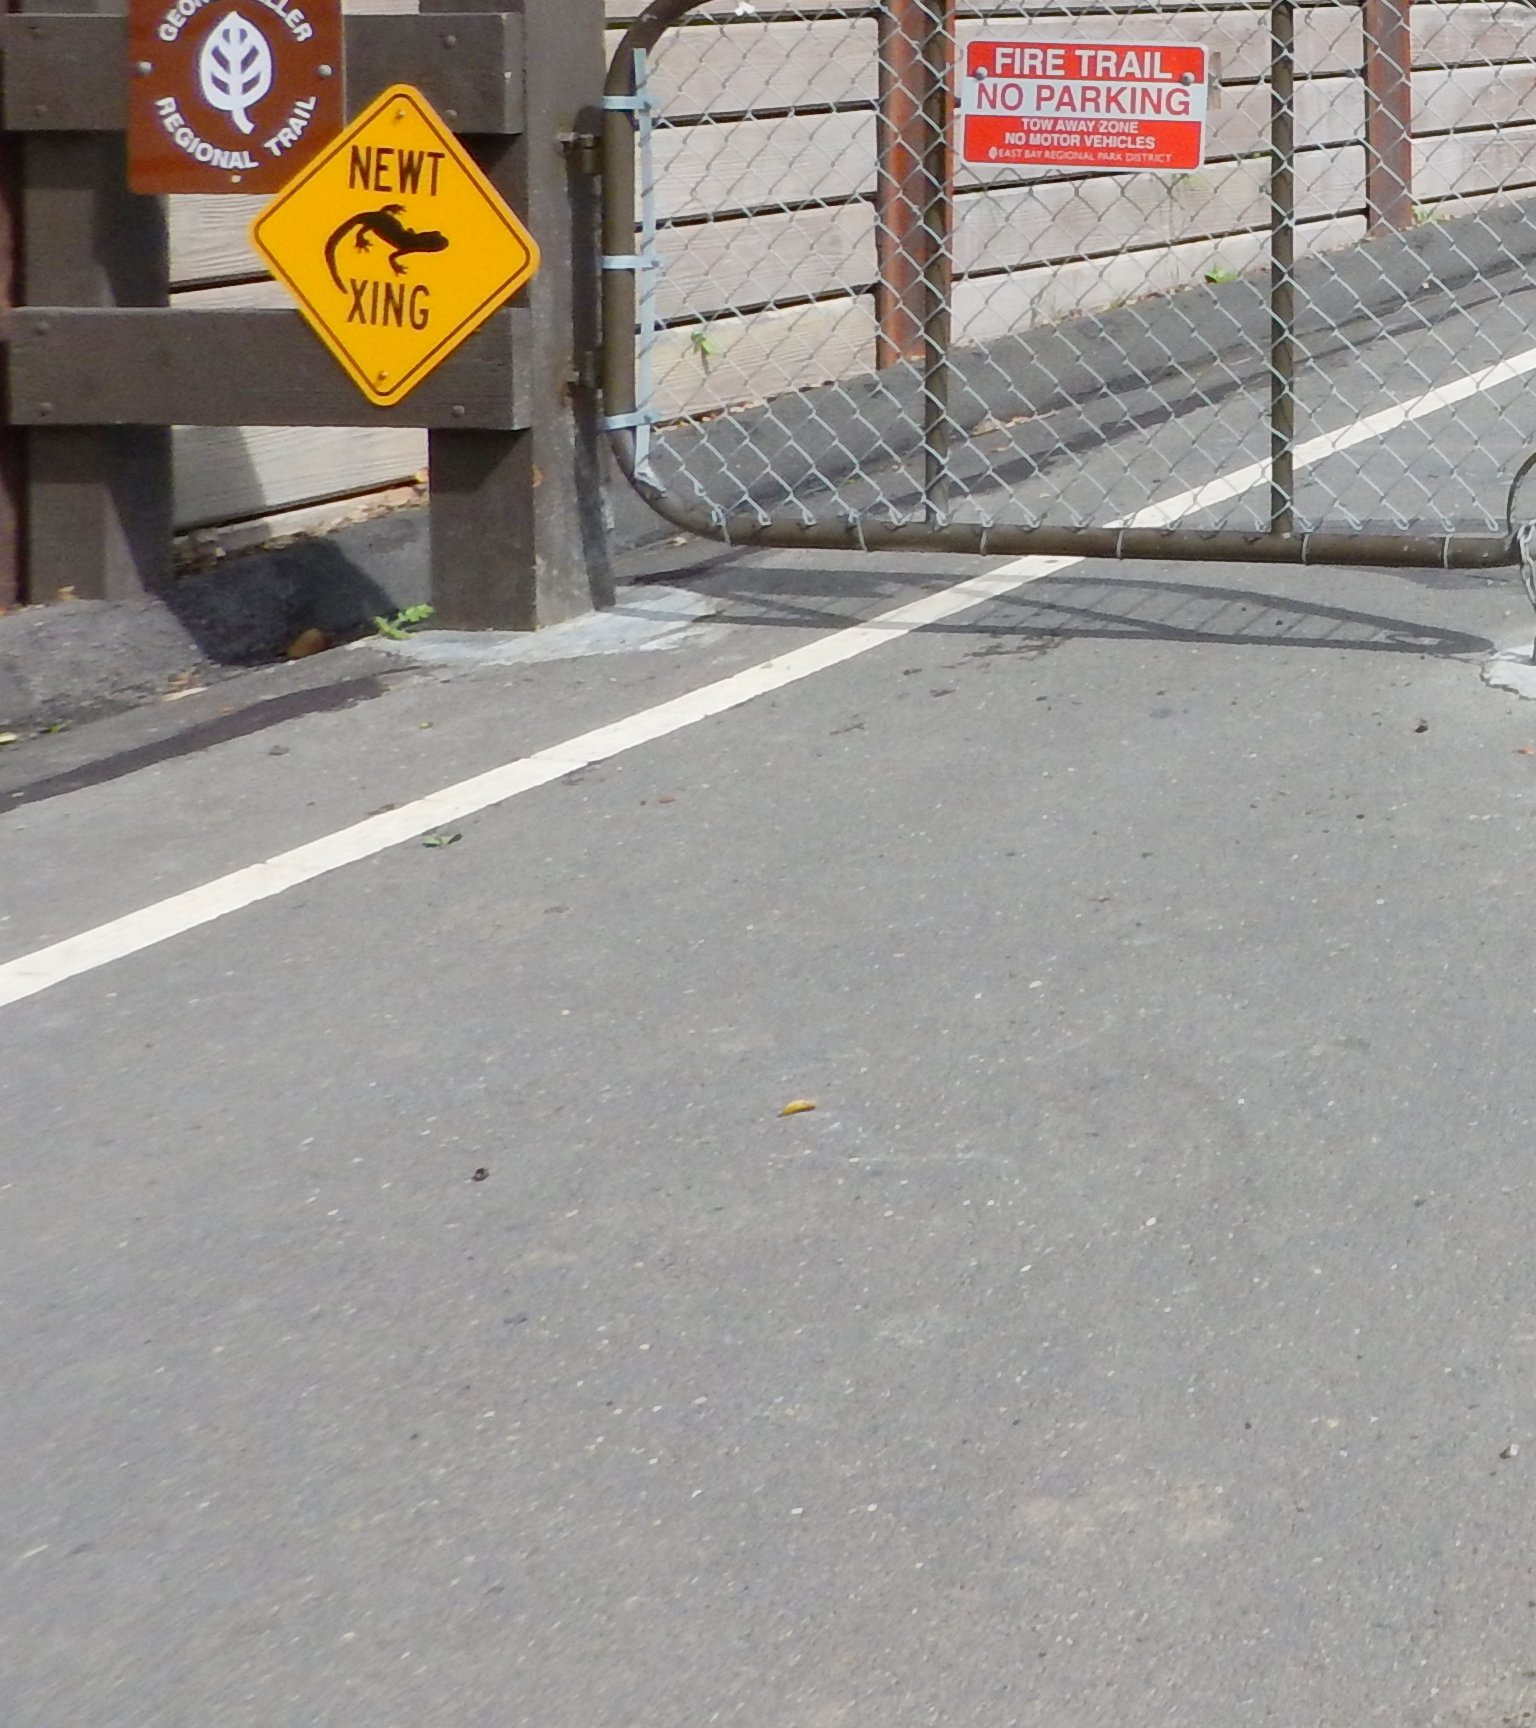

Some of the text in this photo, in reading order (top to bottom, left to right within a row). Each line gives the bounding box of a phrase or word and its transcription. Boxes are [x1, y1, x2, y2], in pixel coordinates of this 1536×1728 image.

[994, 47, 1172, 80] FIRE TRAIL
[976, 83, 1191, 116] NO PARKING
[155, 96, 317, 170] REGIONAL TRAIL
[1004, 132, 1156, 149] NO MOTOR VEHICLES
[1021, 117, 1139, 134] TOW AWAY ZONE
[349, 144, 445, 197] NEWT
[998, 148, 1172, 163] EAST BAY REGIONAL PARK DISTRICT
[347, 278, 430, 331] XING
